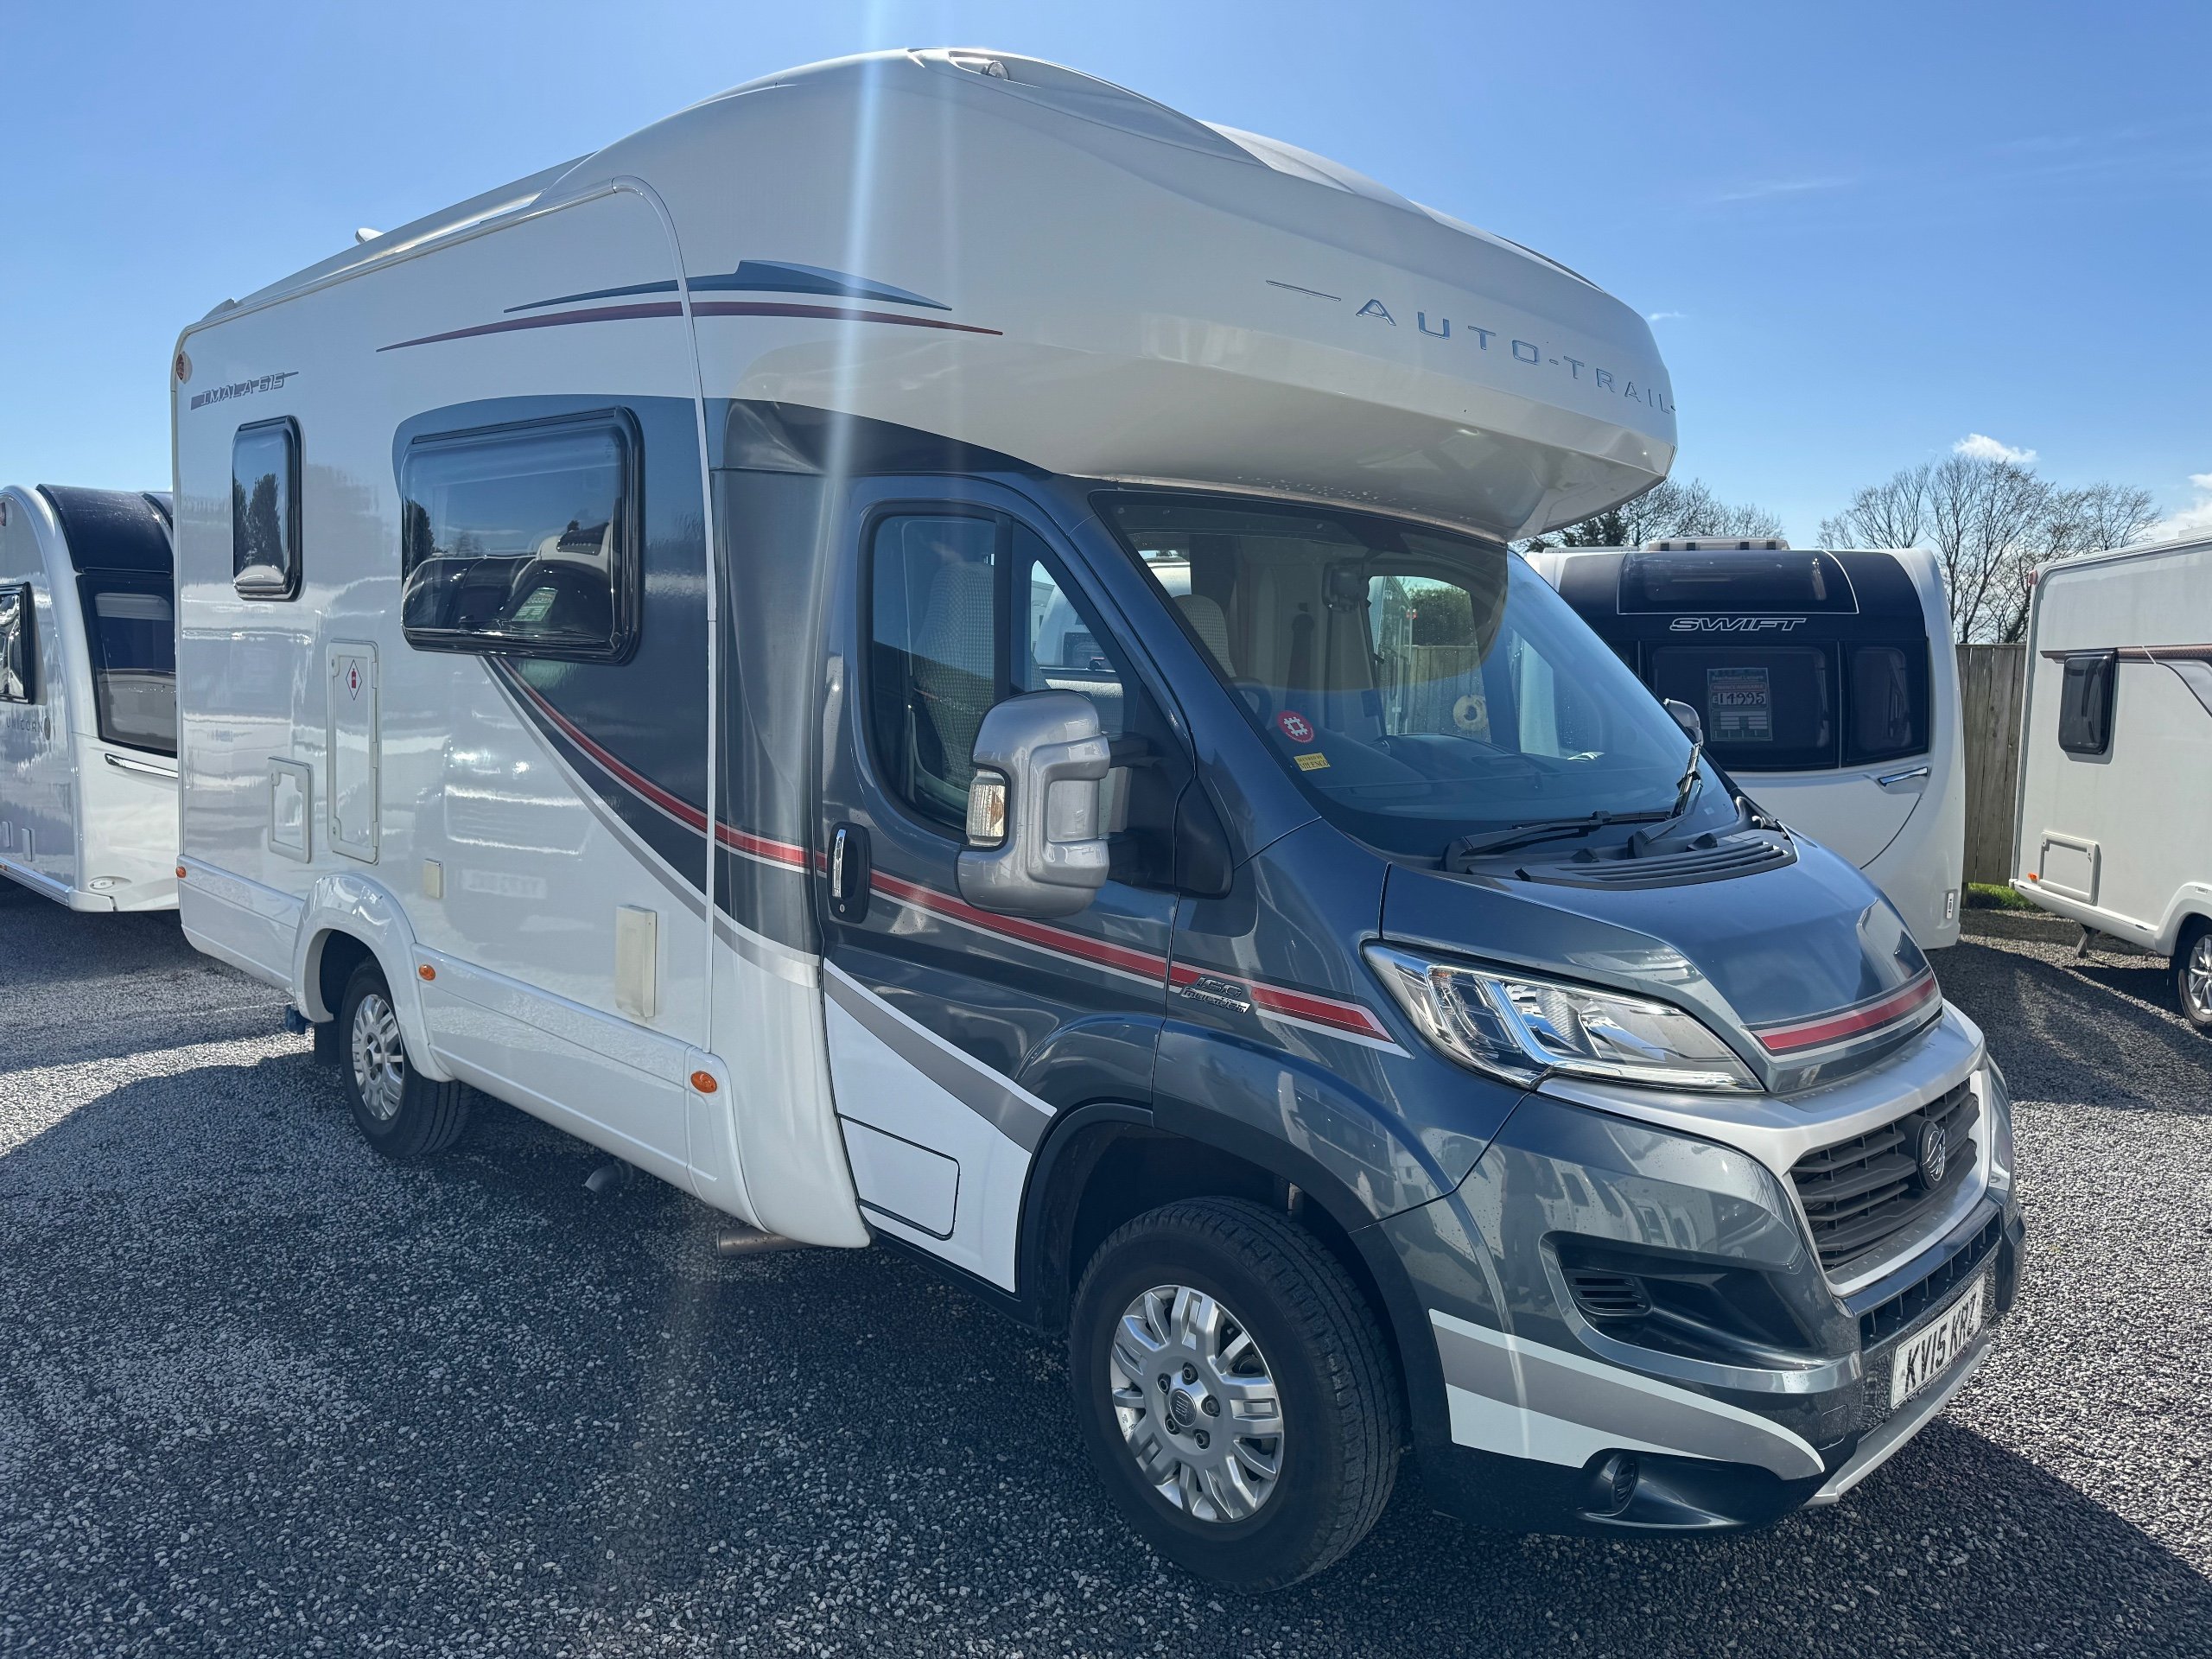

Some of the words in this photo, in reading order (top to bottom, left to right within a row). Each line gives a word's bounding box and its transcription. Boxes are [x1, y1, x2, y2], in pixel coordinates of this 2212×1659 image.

[1356, 298, 1670, 415] AUTO-TRAIL
[201, 379, 254, 405] IMALA
[258, 372, 285, 393] 615
[1669, 617, 1807, 632] SWIFT
[6, 715, 44, 734] UNICORN
[1300, 760, 1329, 769] MILENCO
[1904, 1322, 1948, 1394] KV15
[1948, 1293, 1977, 1357] KRZ
